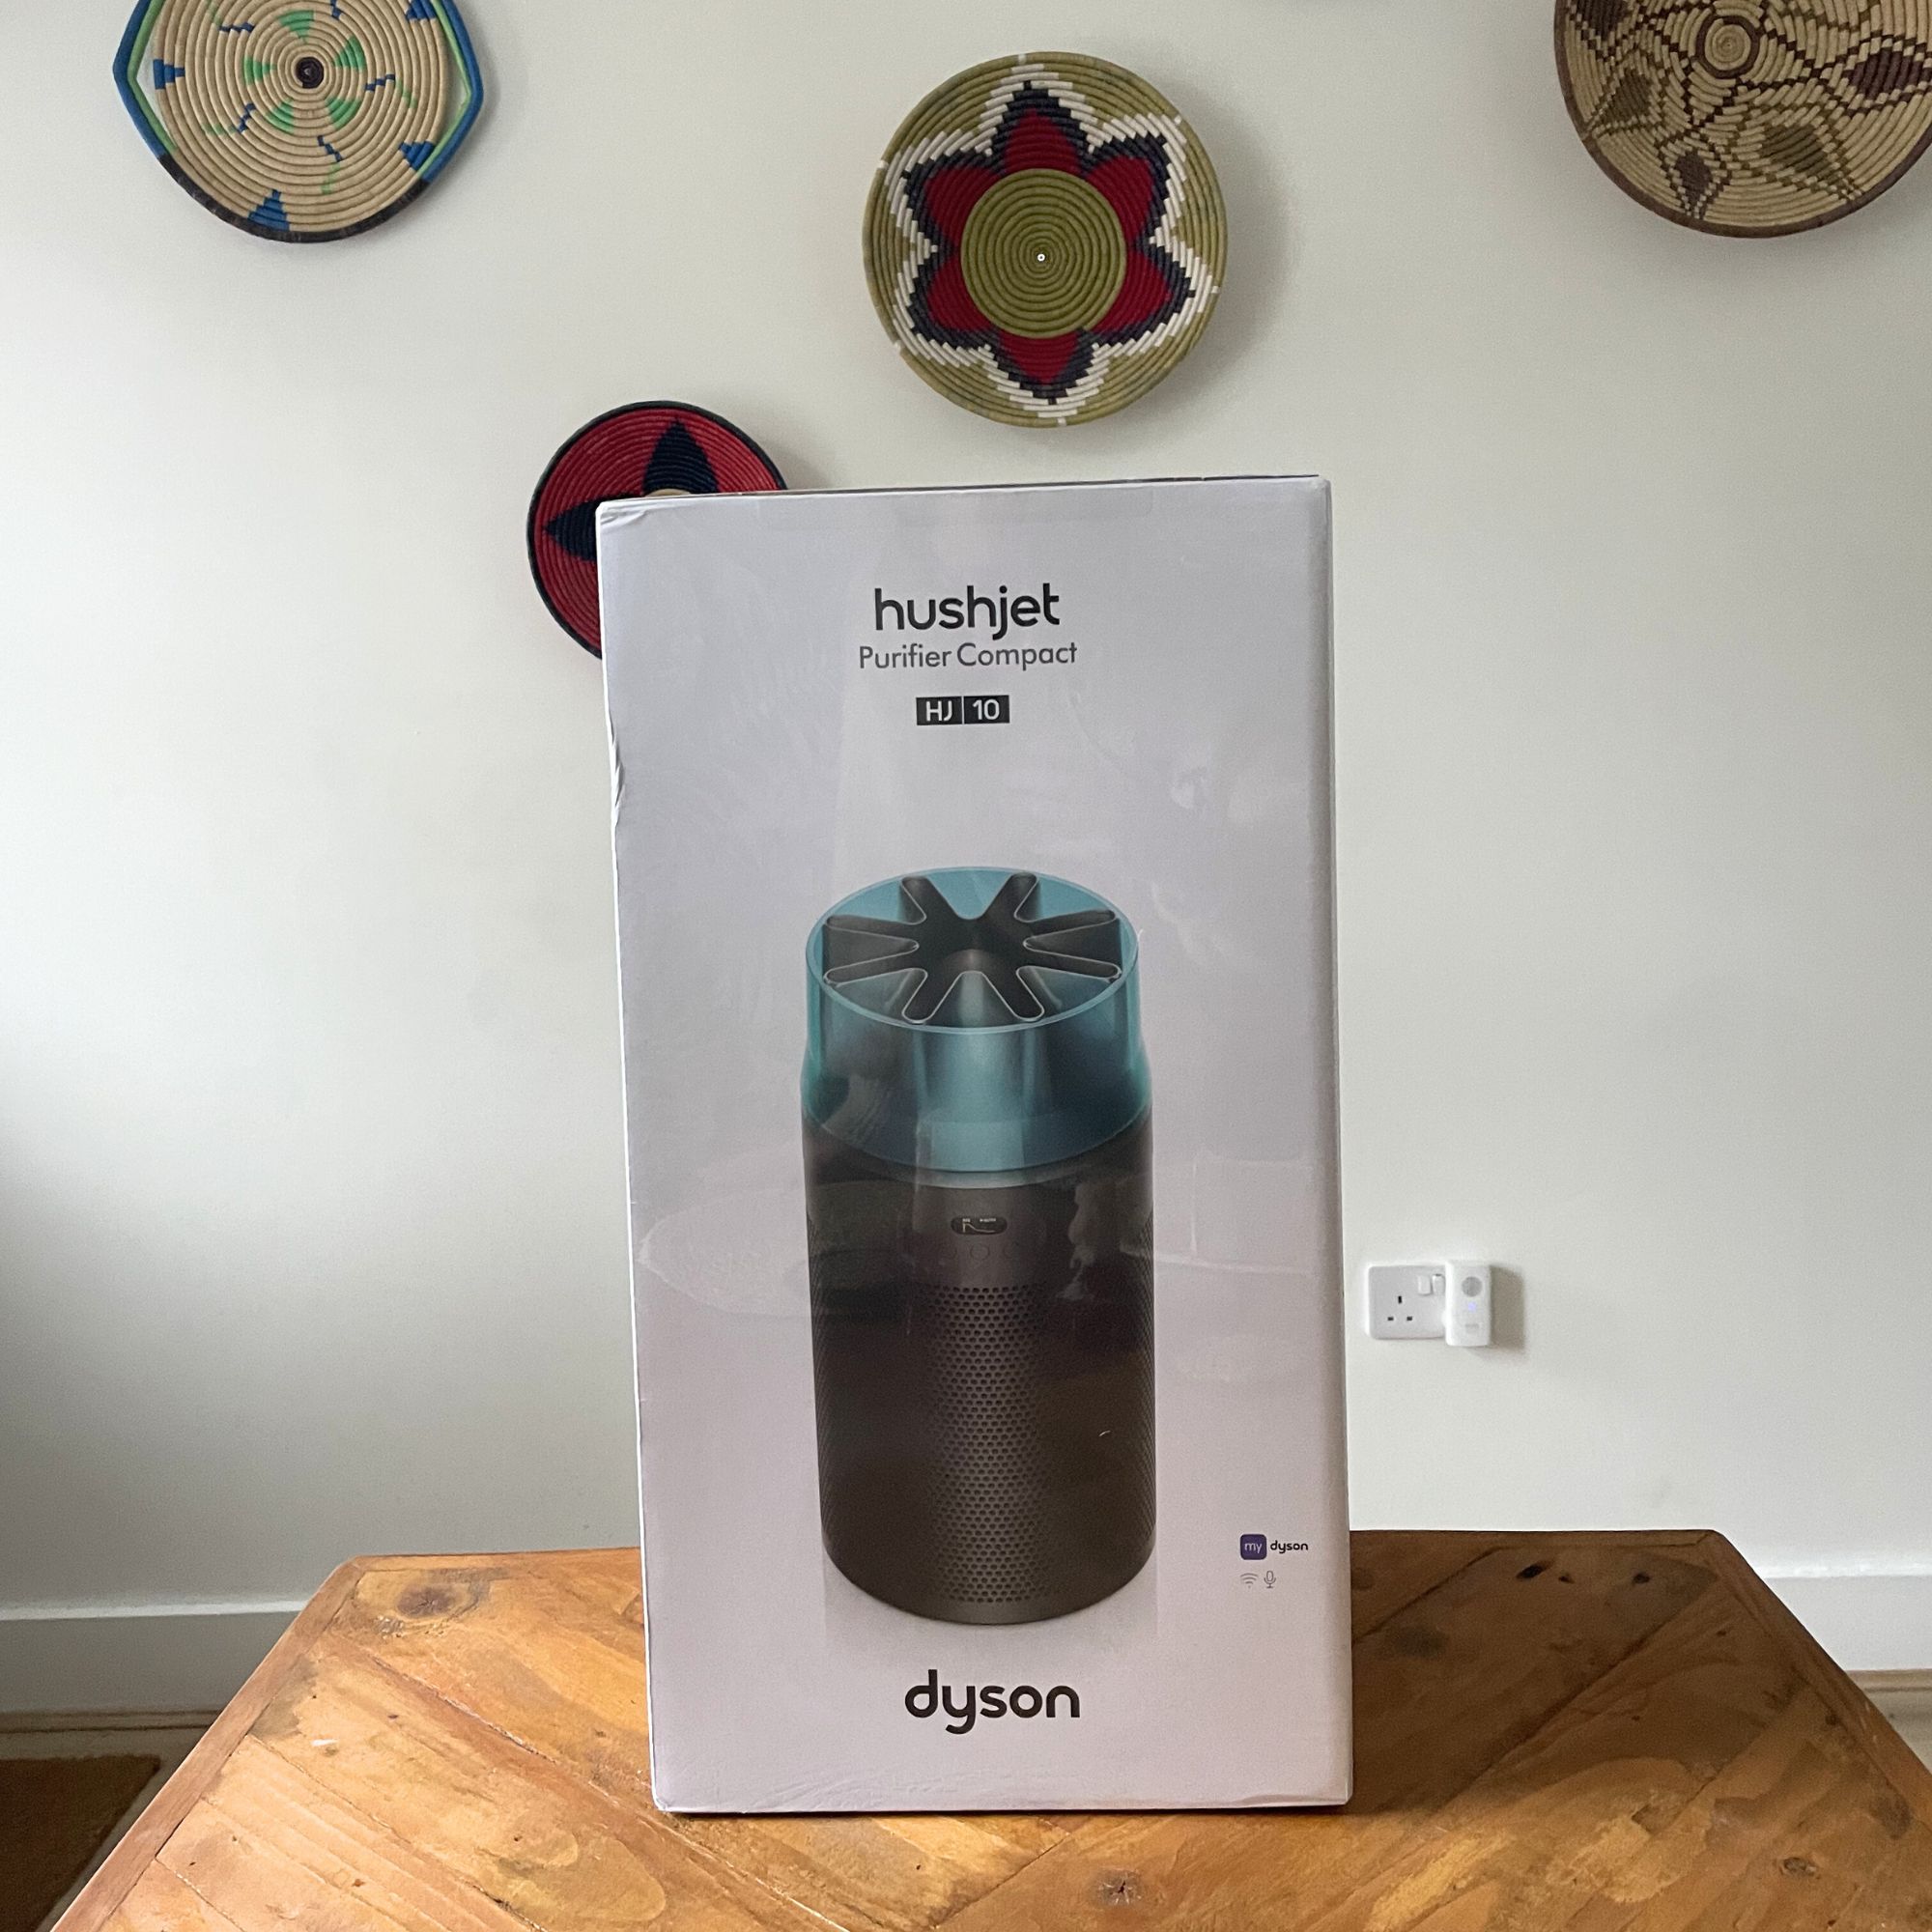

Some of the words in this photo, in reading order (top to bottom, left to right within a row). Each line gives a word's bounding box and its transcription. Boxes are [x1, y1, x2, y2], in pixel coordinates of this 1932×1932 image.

[874, 582, 1060, 640] hushjet
[860, 642, 952, 668] Purifier
[956, 642, 1077, 670] Compact
[924, 700, 952, 722] HJ
[972, 698, 1000, 721] 10
[1244, 1543, 1263, 1553] my
[1269, 1540, 1308, 1553] dyson
[904, 1668, 1080, 1734] dyson
